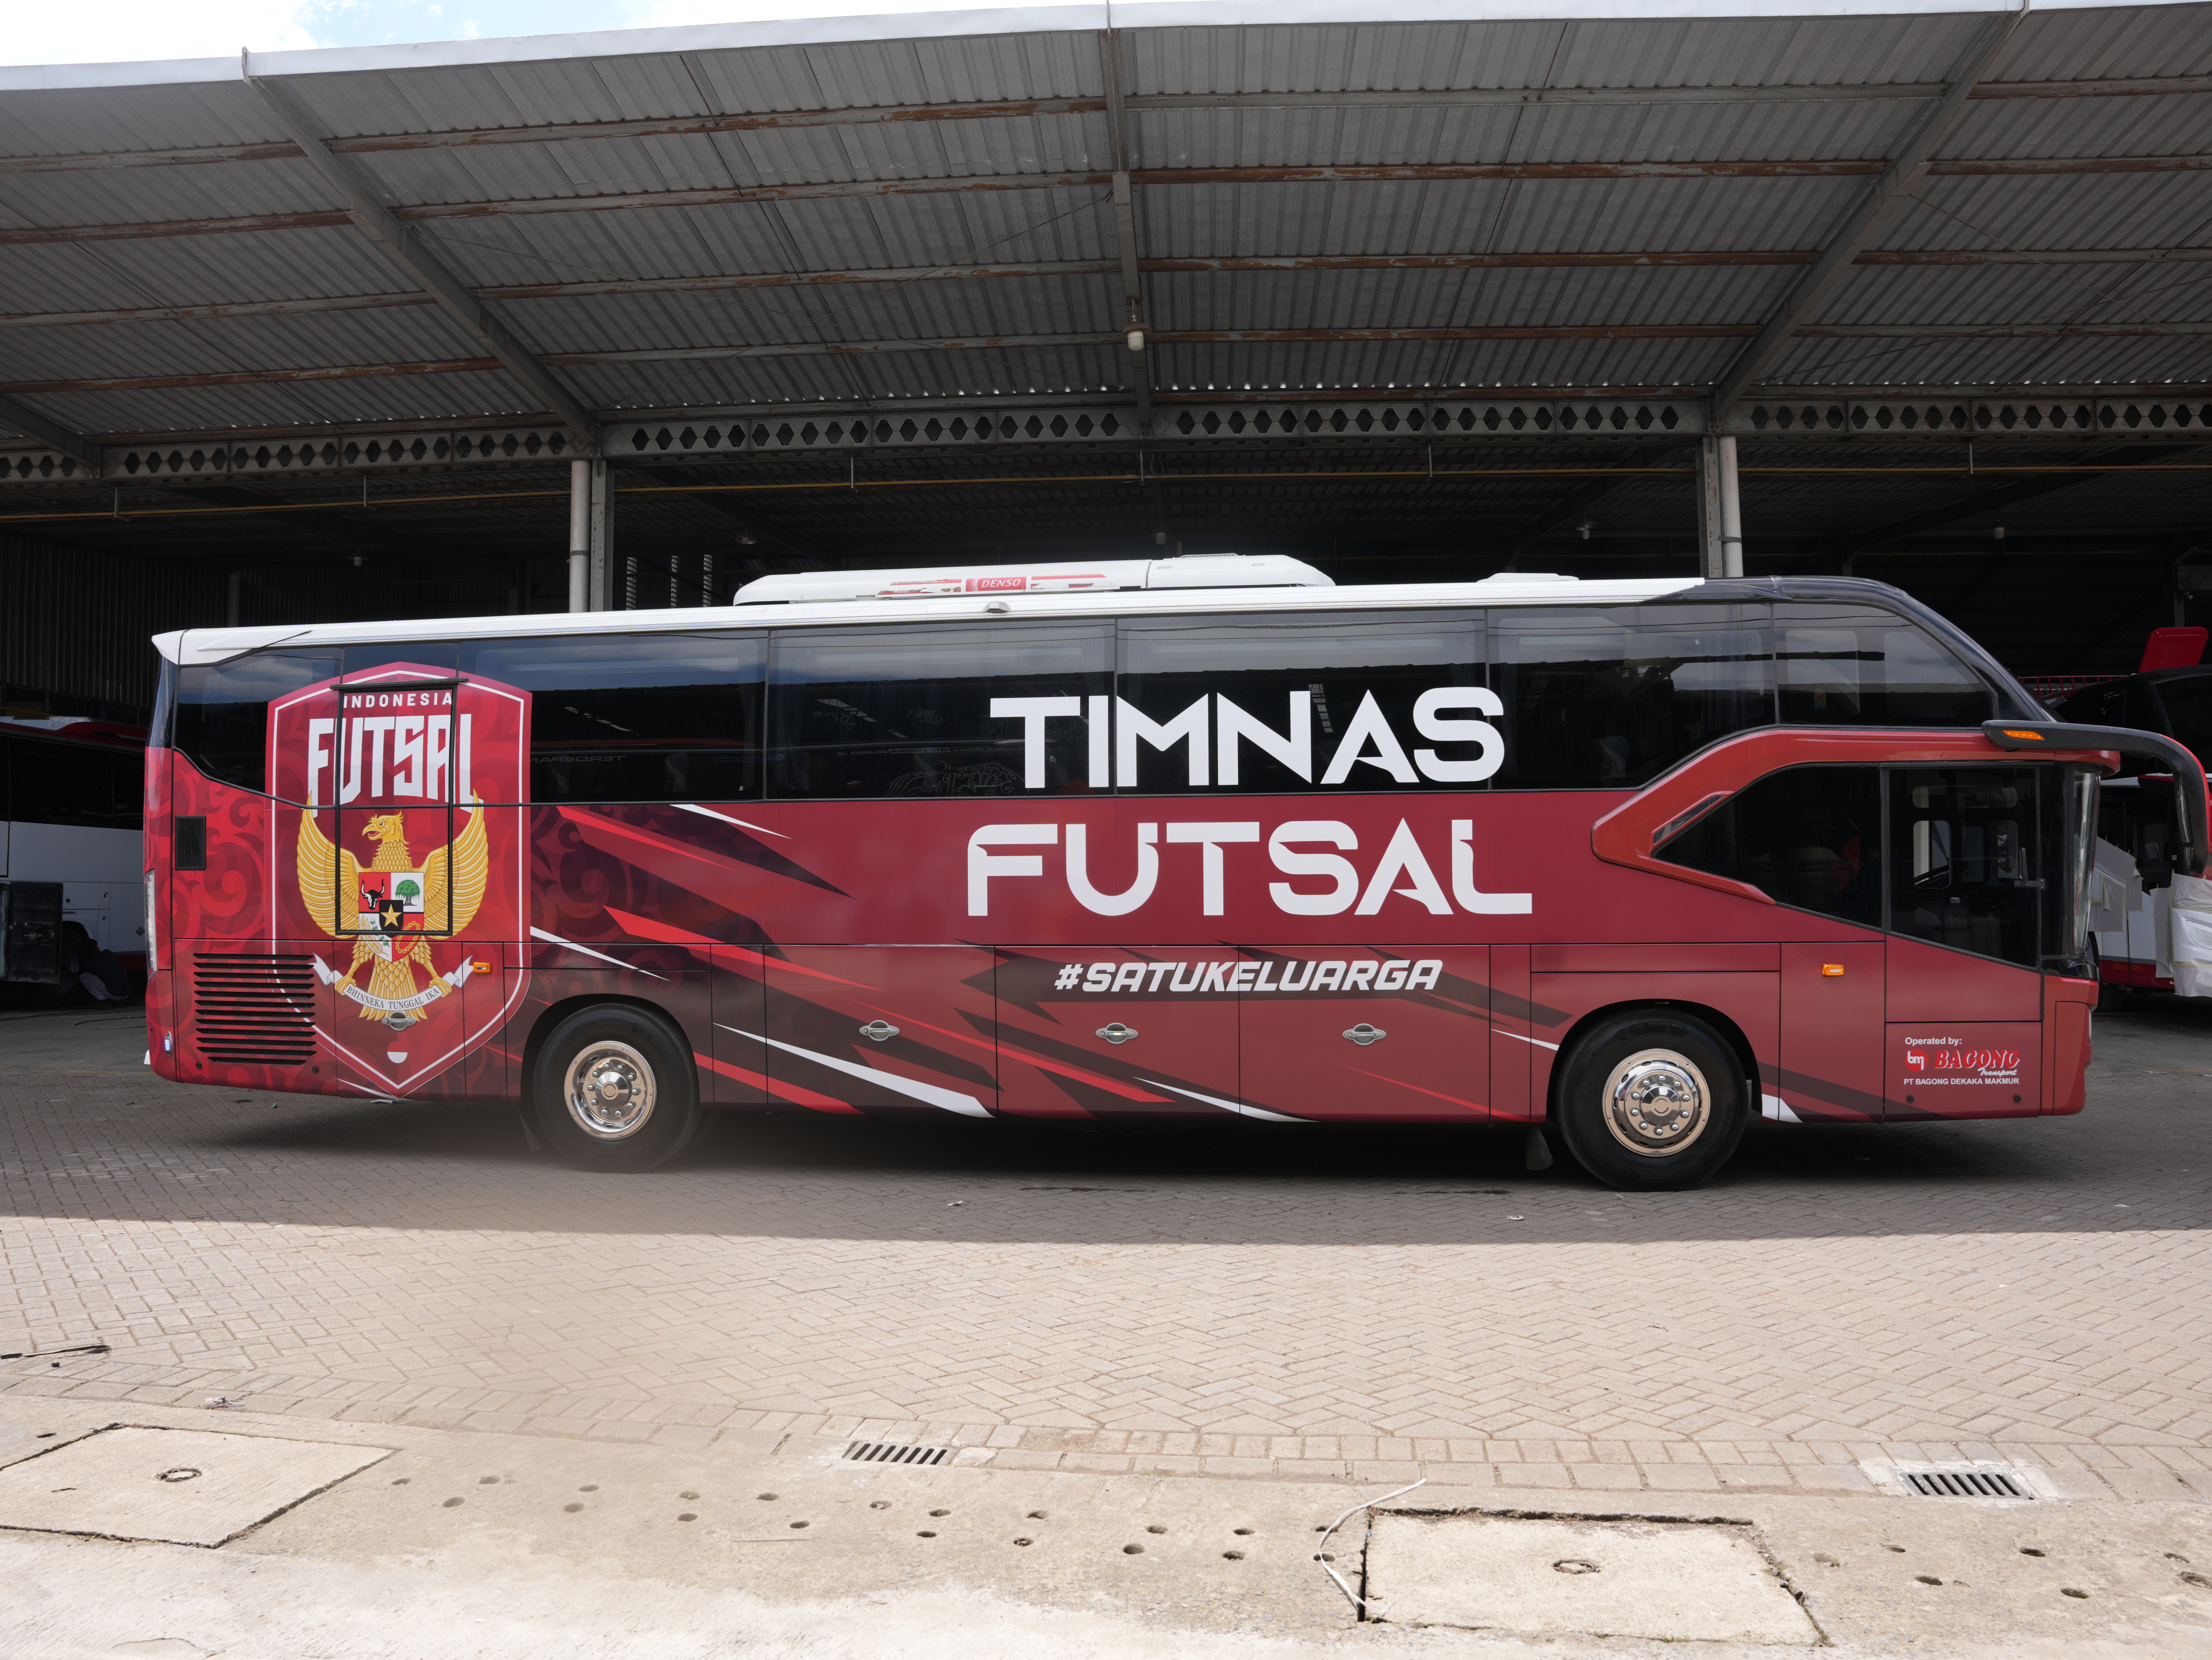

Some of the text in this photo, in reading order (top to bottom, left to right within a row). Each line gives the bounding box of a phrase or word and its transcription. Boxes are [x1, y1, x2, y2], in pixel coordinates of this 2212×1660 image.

[981, 579, 1021, 588] DENSO
[343, 692, 452, 708] INDONESIA
[990, 687, 1505, 788] TIMNAS
[308, 713, 484, 818] FUTSAL
[967, 818, 1532, 916] FUTSAL
[1054, 959, 1443, 992] #SATUKELUARGA
[346, 986, 439, 1009] BHINNEKA TUNGGAL IKA
[1905, 1037, 1962, 1046] Operated by:
[1934, 1050, 2020, 1069] BAGONG
[1977, 1068, 2017, 1077] Transport
